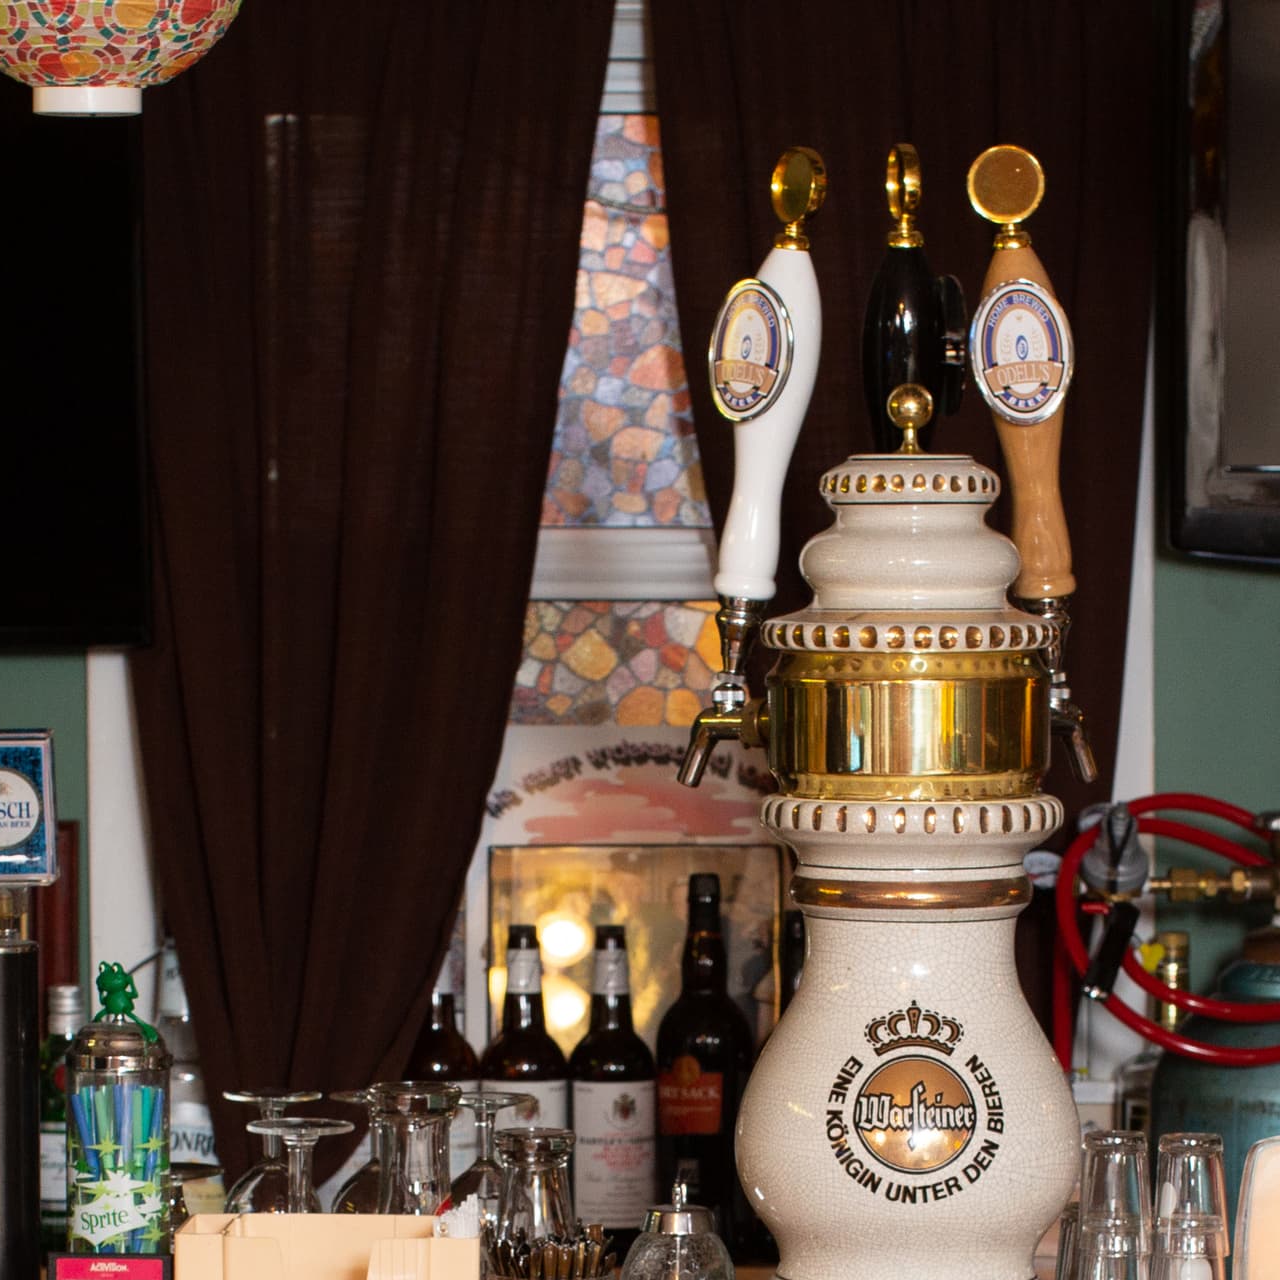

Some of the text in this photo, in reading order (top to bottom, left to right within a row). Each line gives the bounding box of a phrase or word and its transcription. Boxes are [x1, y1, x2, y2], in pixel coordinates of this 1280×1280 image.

[988, 294, 1049, 328] HOME BREWED
[996, 364, 1050, 386] ODELL'S
[725, 392, 755, 407] BEER
[1007, 393, 1045, 408] BEER
[826, 1054, 1005, 1204] EINE KÖNIGIN UNTER DEN BIEREN
[858, 1081, 977, 1151] Warsteiner
[80, 1206, 130, 1234] Sprite
